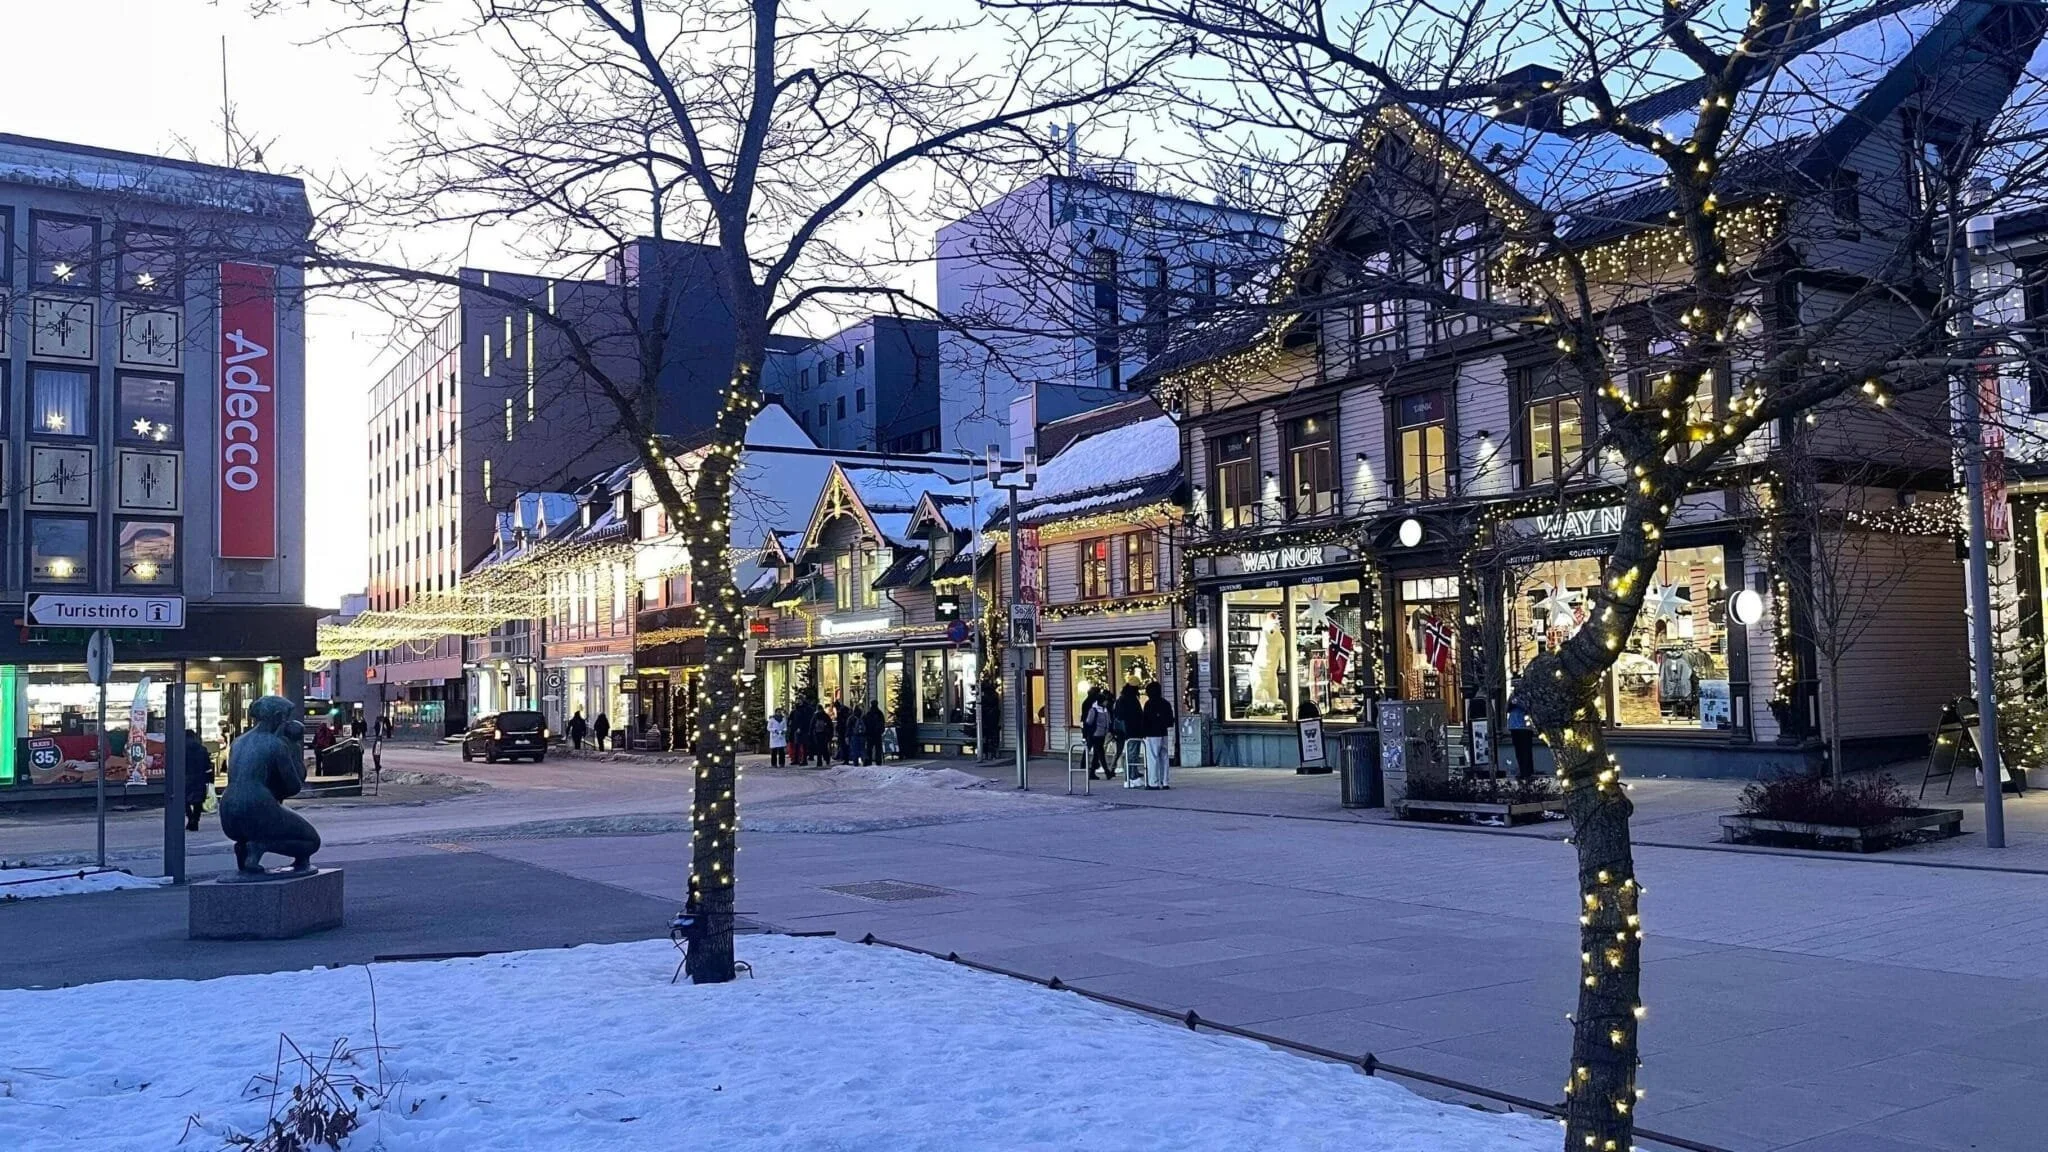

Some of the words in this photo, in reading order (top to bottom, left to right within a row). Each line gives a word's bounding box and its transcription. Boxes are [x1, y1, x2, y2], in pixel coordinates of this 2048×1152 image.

[225, 328, 271, 491] Adecco
[1536, 509, 1596, 540] WAY
[1600, 505, 1627, 534] N
[1240, 550, 1279, 572] WAY
[1281, 546, 1323, 568] NOR
[1265, 580, 1279, 588] GIFTS
[1301, 575, 1324, 584] CLOTHES
[54, 603, 139, 618] Turistinfo
